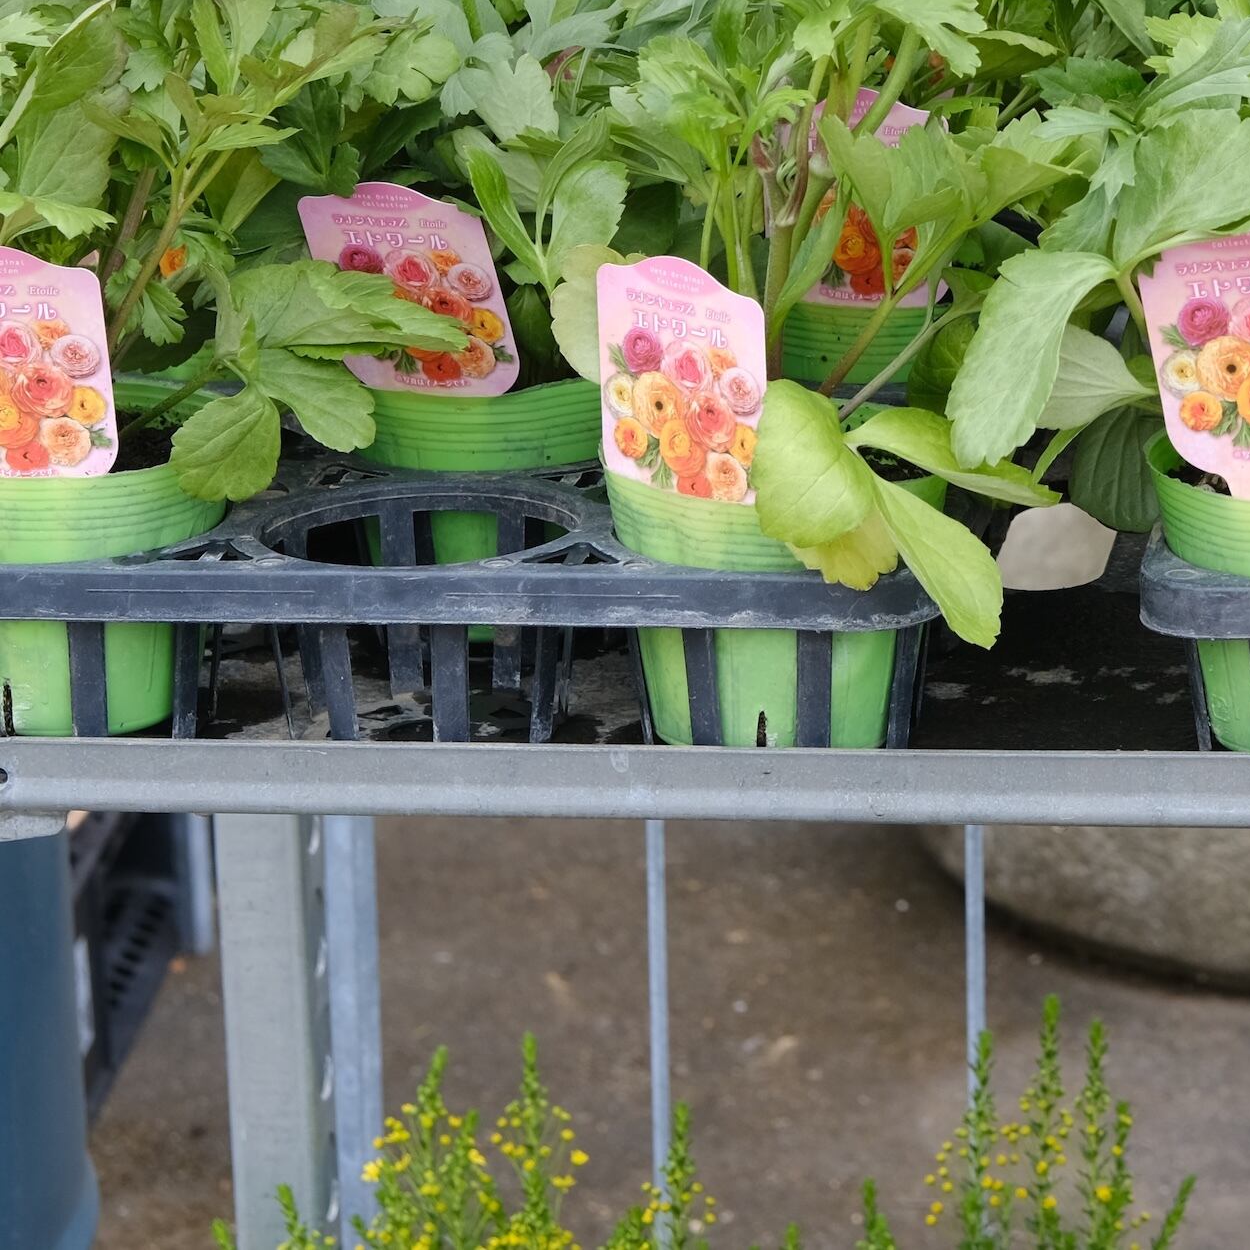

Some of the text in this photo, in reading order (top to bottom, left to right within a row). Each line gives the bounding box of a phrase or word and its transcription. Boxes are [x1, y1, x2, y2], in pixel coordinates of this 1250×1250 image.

[884, 127, 910, 136] Etoil
[361, 201, 409, 209] Collection
[420, 219, 447, 229] Etoile
[344, 230, 448, 250] エトワール
[29, 286, 60, 296] Etoile
[633, 310, 728, 348] エトワール
